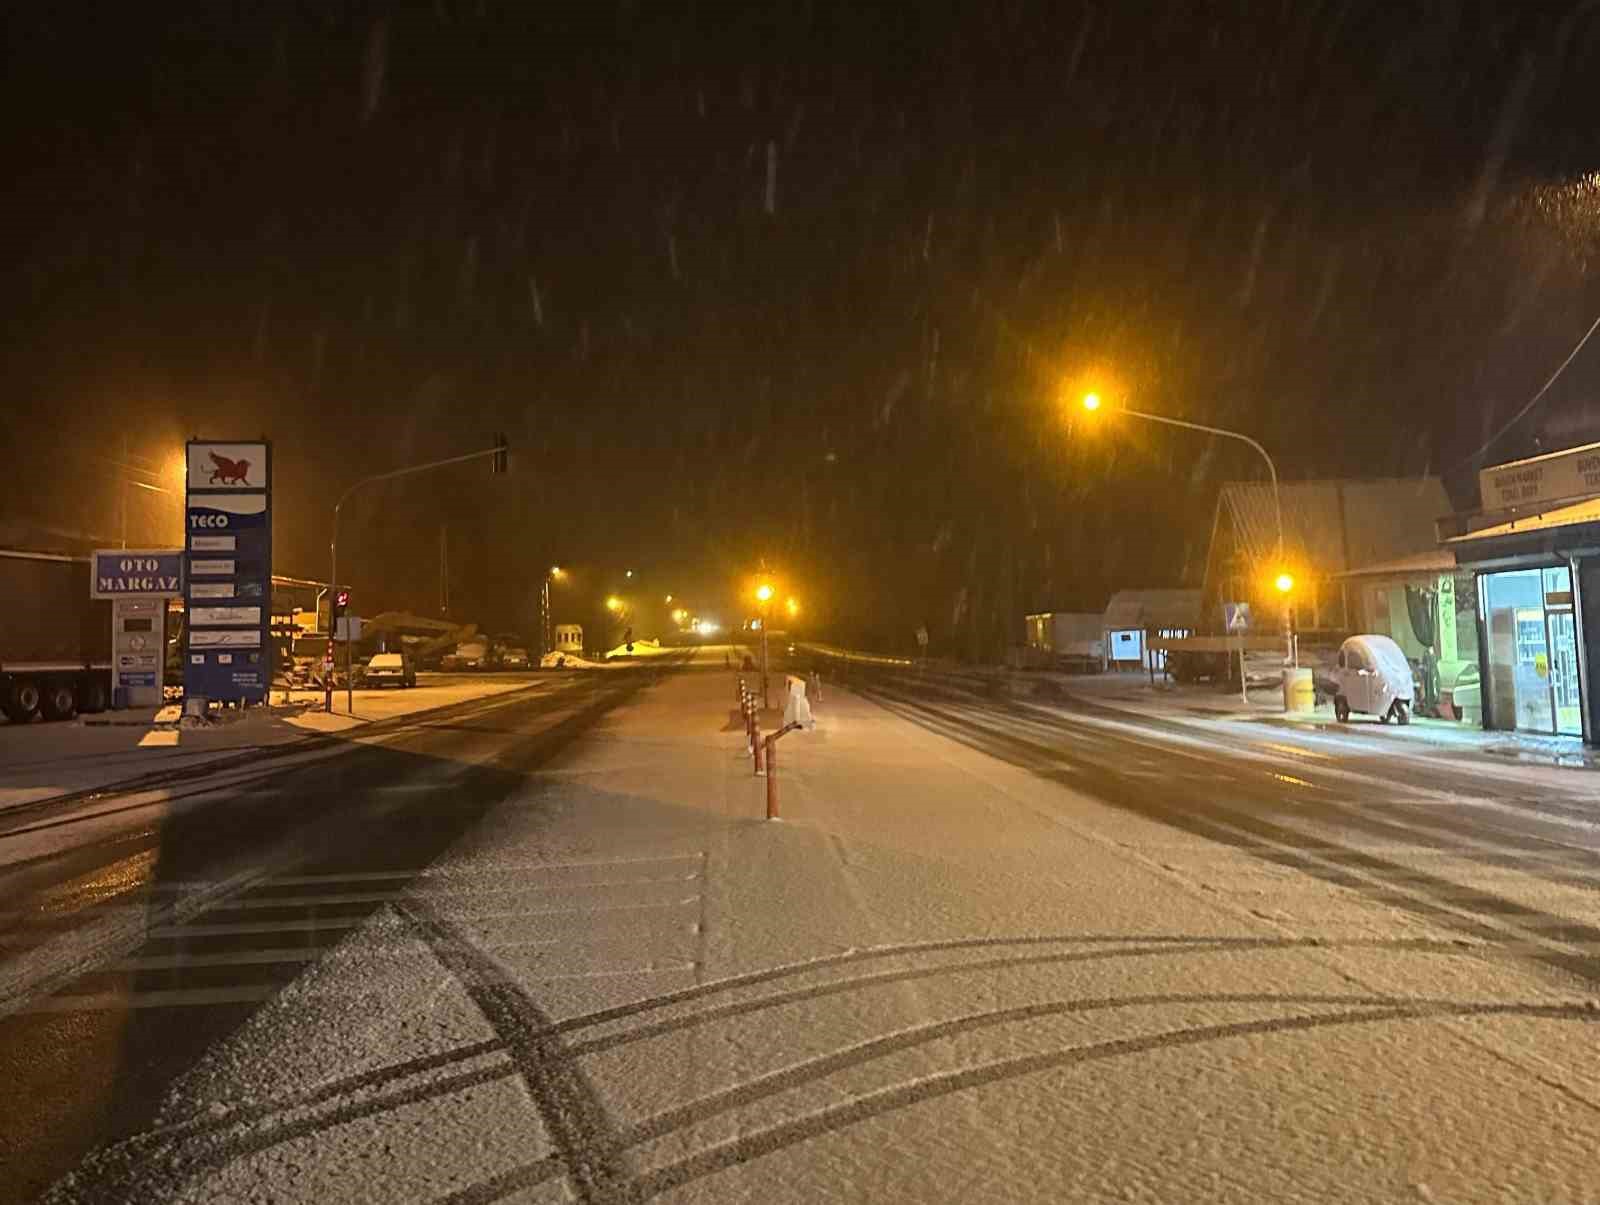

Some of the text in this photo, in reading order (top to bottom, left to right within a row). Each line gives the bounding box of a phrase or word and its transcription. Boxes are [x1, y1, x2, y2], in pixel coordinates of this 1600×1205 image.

[191, 515, 228, 529] TECO
[120, 559, 159, 572] OTO
[98, 576, 178, 591] MARGAZ
